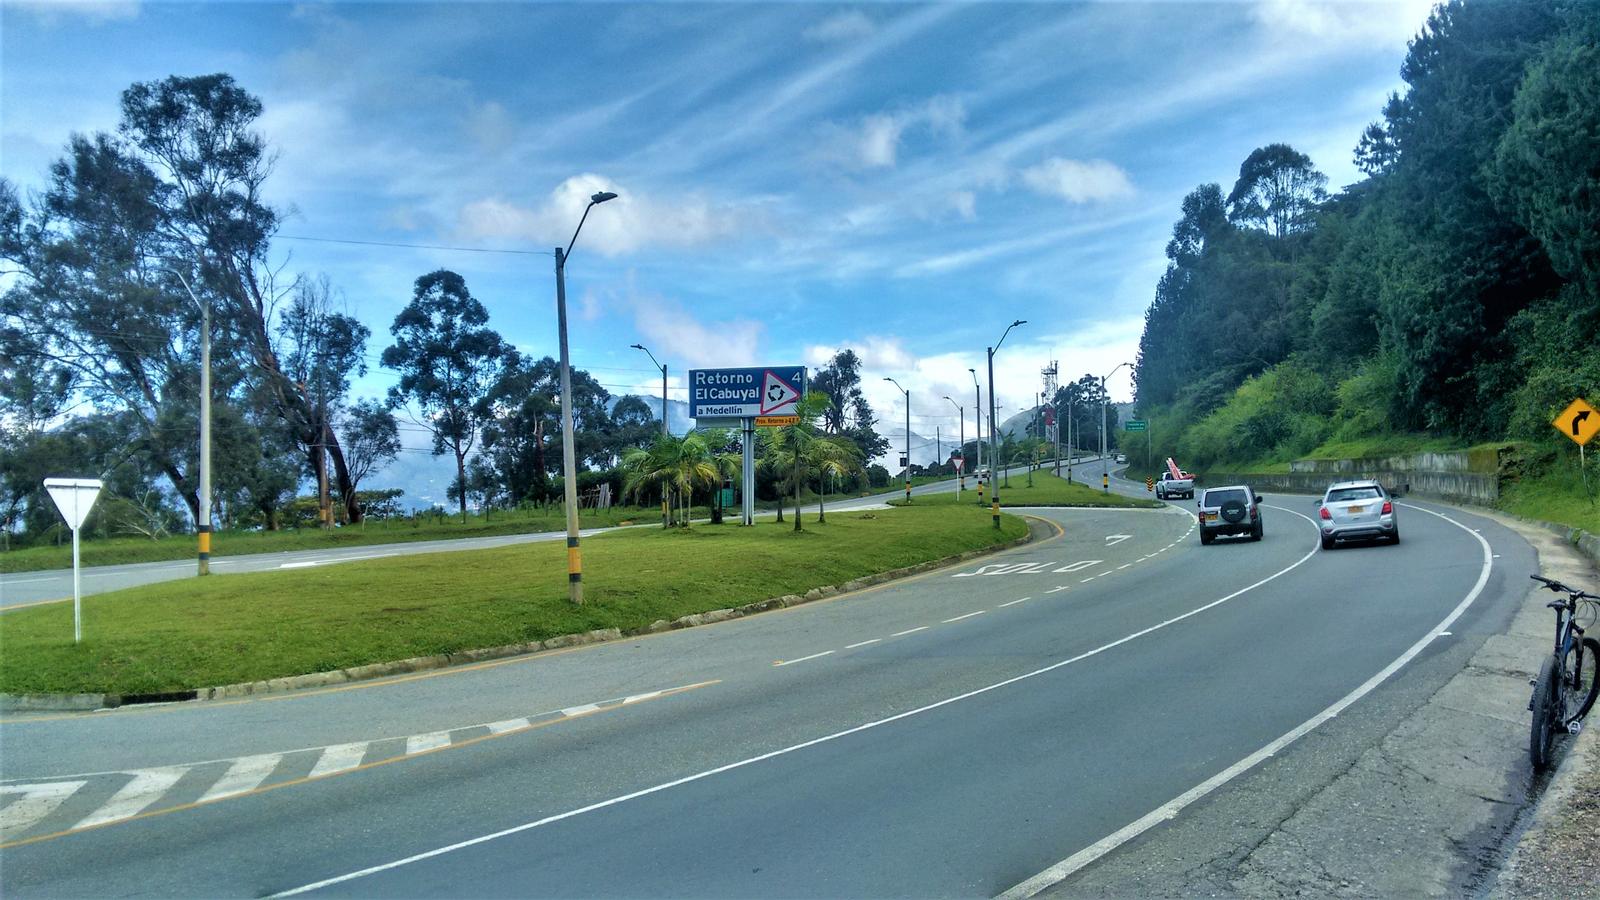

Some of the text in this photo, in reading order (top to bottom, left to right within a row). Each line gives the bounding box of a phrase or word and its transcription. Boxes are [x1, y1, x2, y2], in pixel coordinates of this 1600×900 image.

[696, 372, 753, 385] Retorno
[791, 371, 801, 383] 4
[696, 387, 760, 401] El Cabuyal
